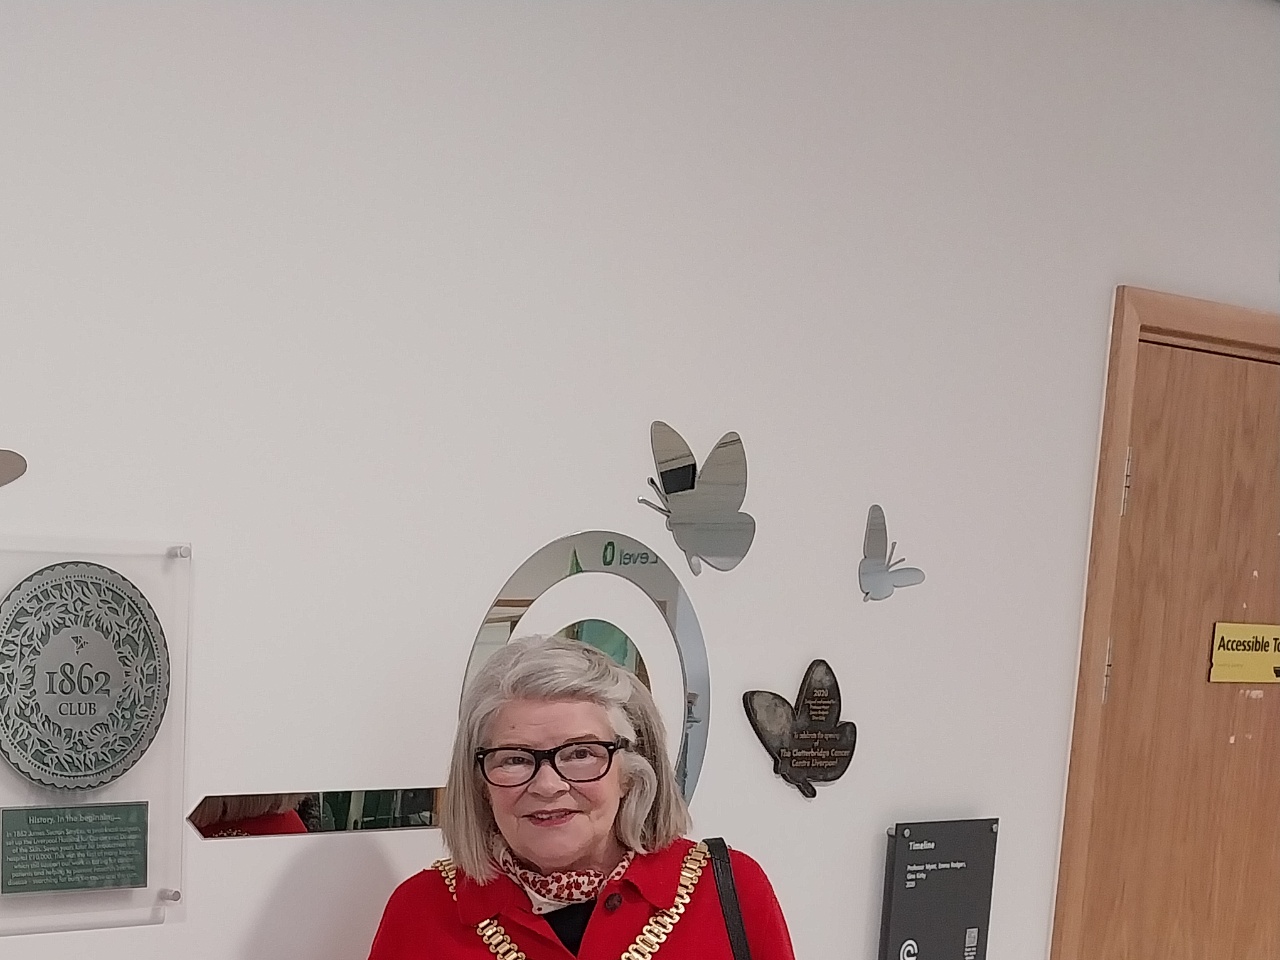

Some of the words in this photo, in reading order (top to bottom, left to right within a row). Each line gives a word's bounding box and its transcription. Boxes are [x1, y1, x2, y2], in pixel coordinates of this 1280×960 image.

[1217, 635, 1270, 652] Accessible
[45, 662, 111, 698] 1862
[58, 702, 97, 716] CLUB
[65, 813, 78, 823] the
[908, 840, 936, 851] Timeline
